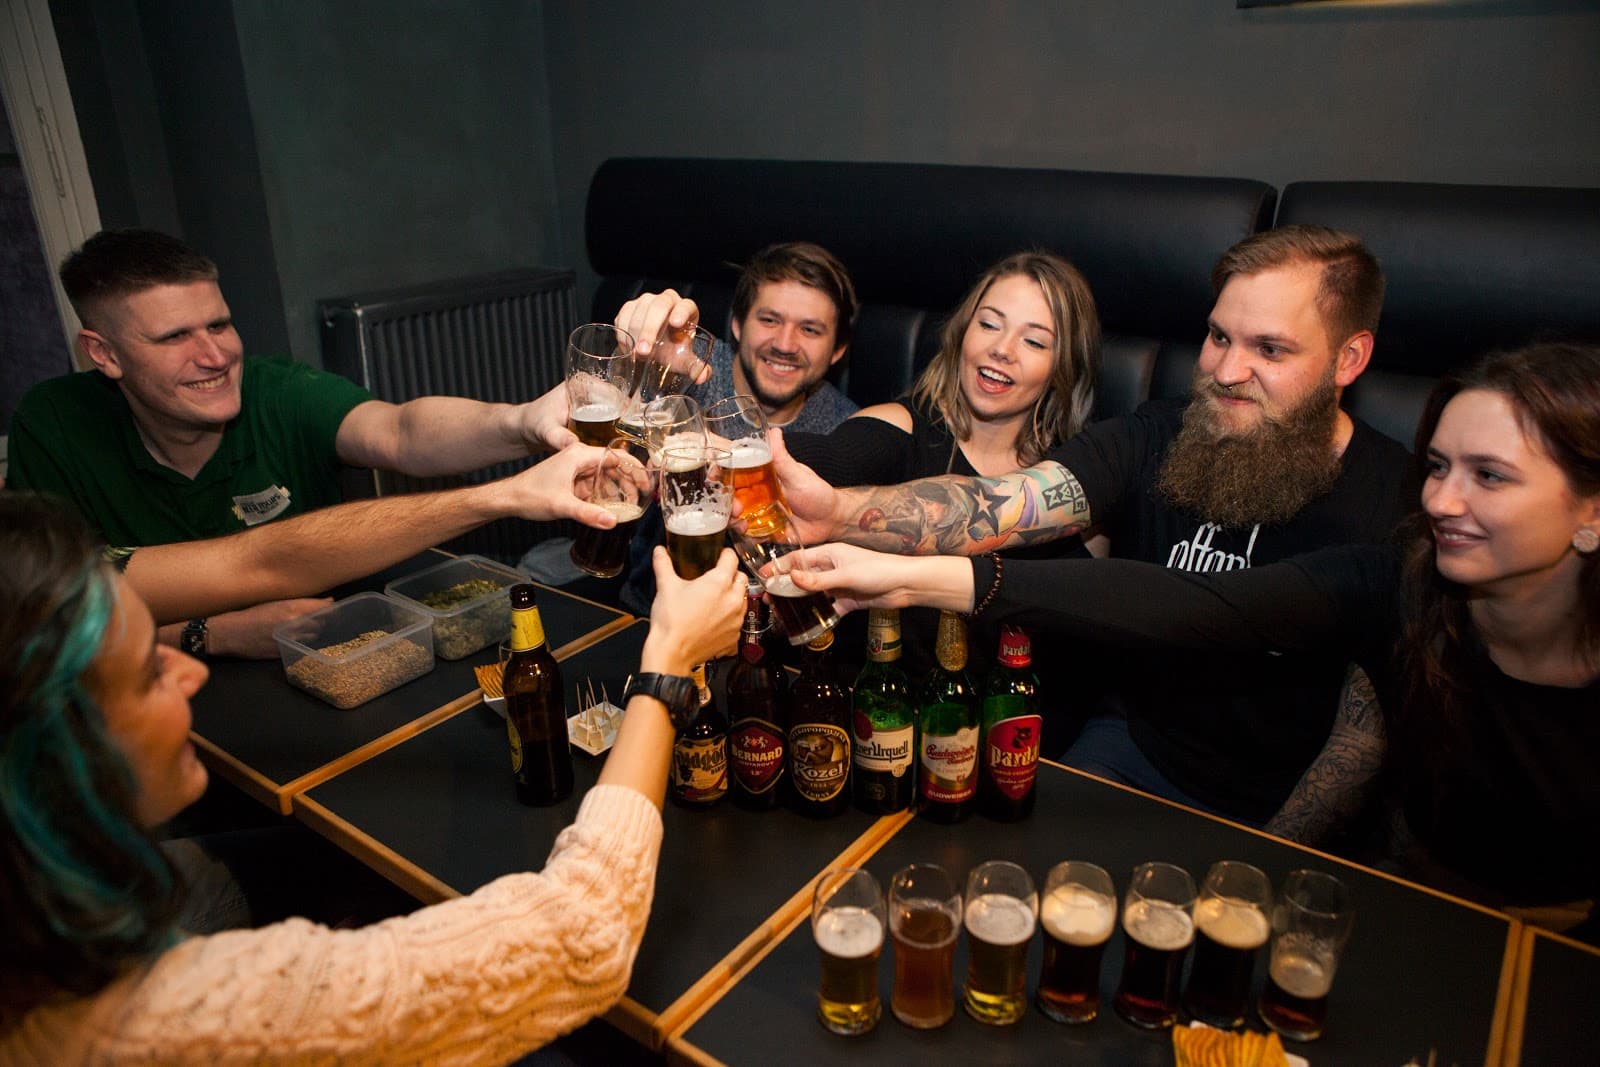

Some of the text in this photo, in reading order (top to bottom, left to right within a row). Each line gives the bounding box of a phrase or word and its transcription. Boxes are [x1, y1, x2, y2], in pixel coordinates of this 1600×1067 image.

[731, 744, 783, 762] BERNARD
[871, 739, 909, 763] Urquell
[793, 761, 844, 781] Kozel
